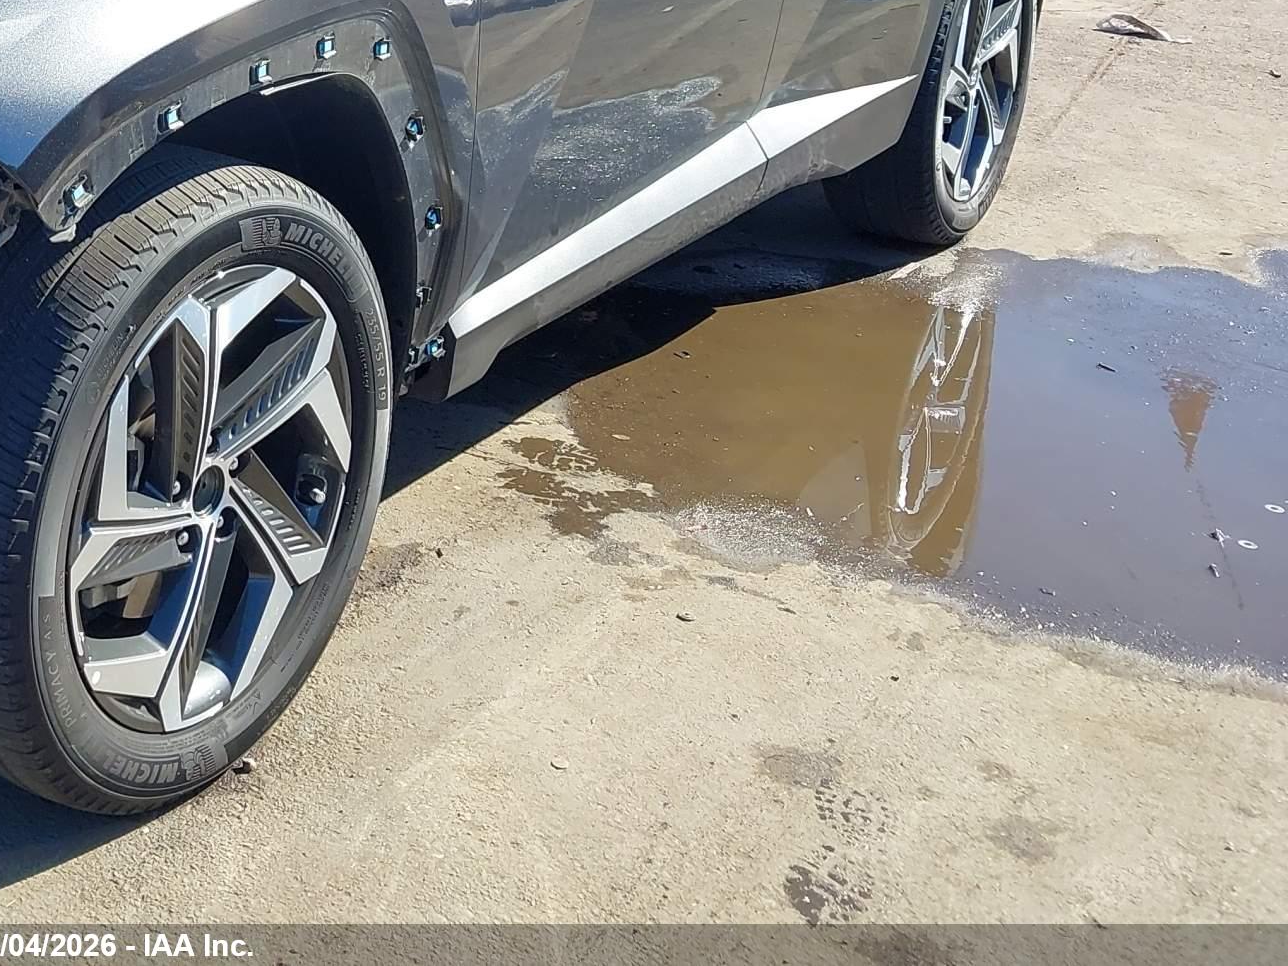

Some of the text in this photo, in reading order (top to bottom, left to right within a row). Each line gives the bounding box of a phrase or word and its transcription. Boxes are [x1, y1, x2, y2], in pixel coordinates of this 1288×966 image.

[376, 367, 385, 378] R
[376, 386, 386, 401] 19
[46, 651, 77, 728] PRIMACY
